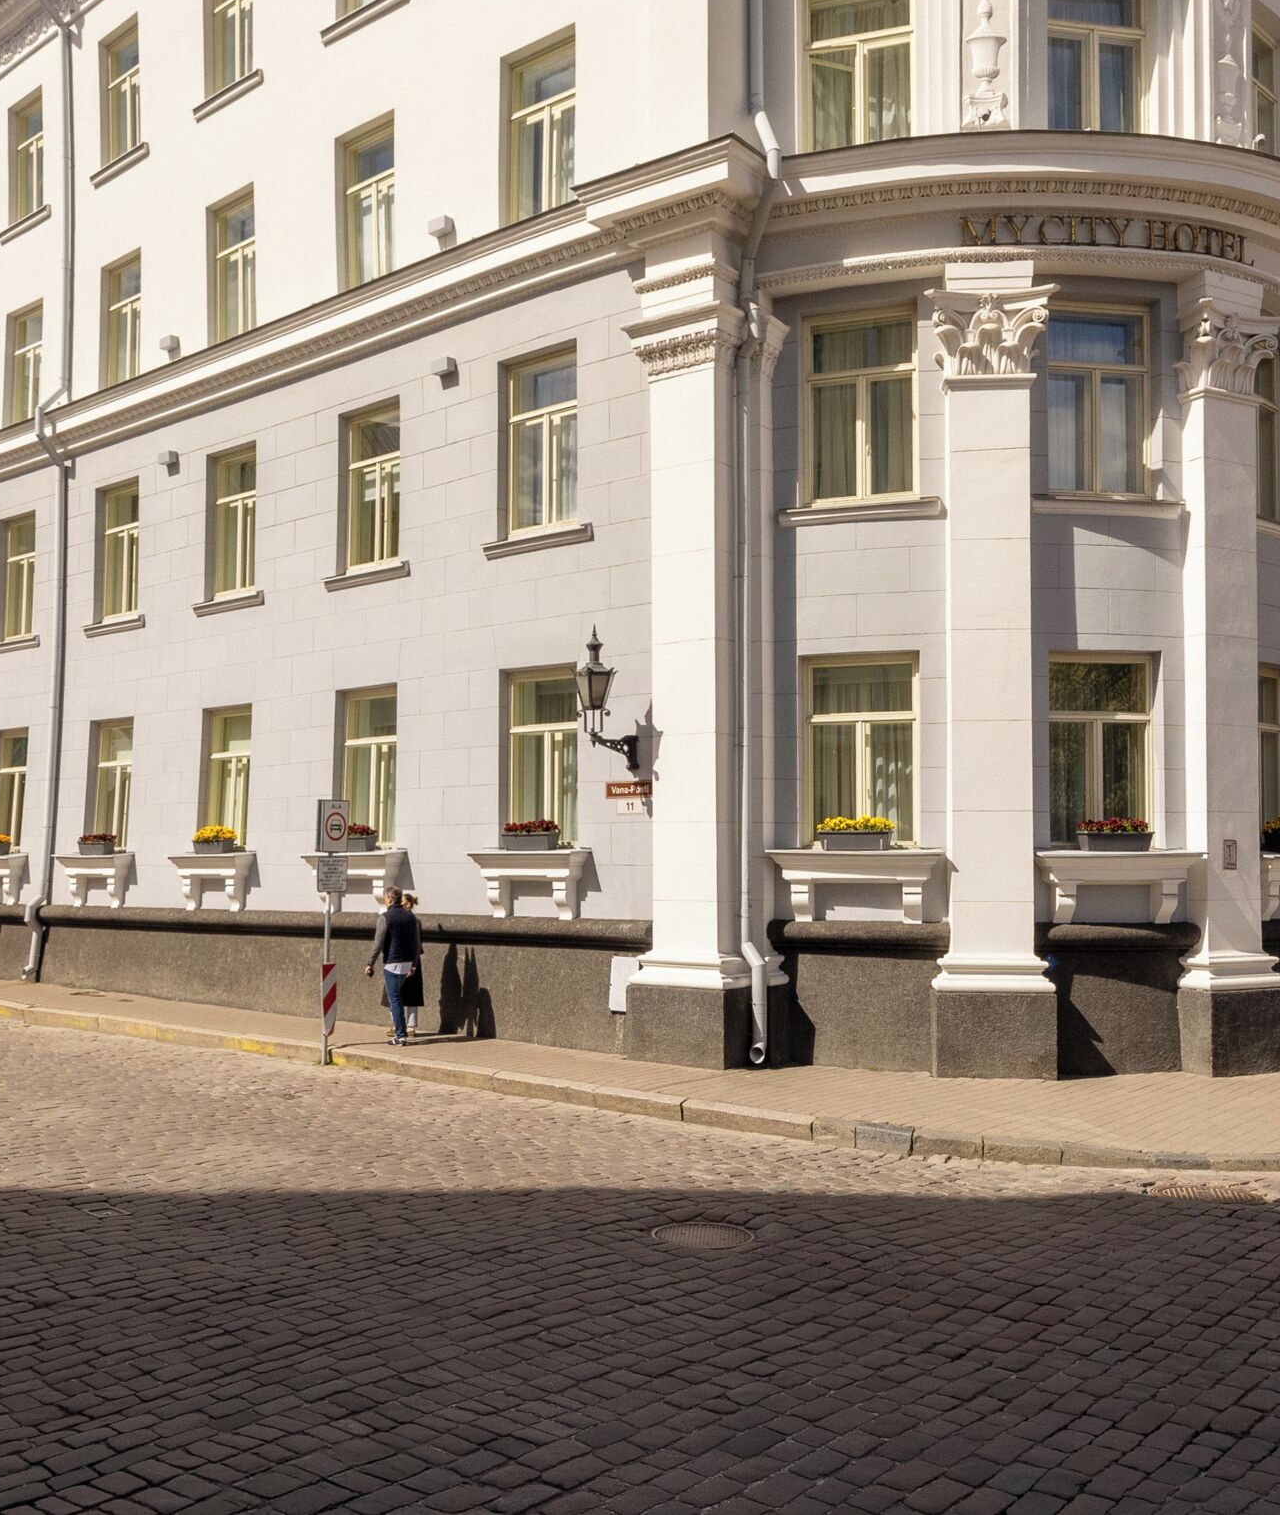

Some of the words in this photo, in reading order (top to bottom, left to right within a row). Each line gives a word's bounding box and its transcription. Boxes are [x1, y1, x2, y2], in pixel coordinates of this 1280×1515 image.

[1146, 220, 1255, 266] HOTEL
[611, 785, 649, 795] Vana-Posti
[626, 801, 634, 811] 11
